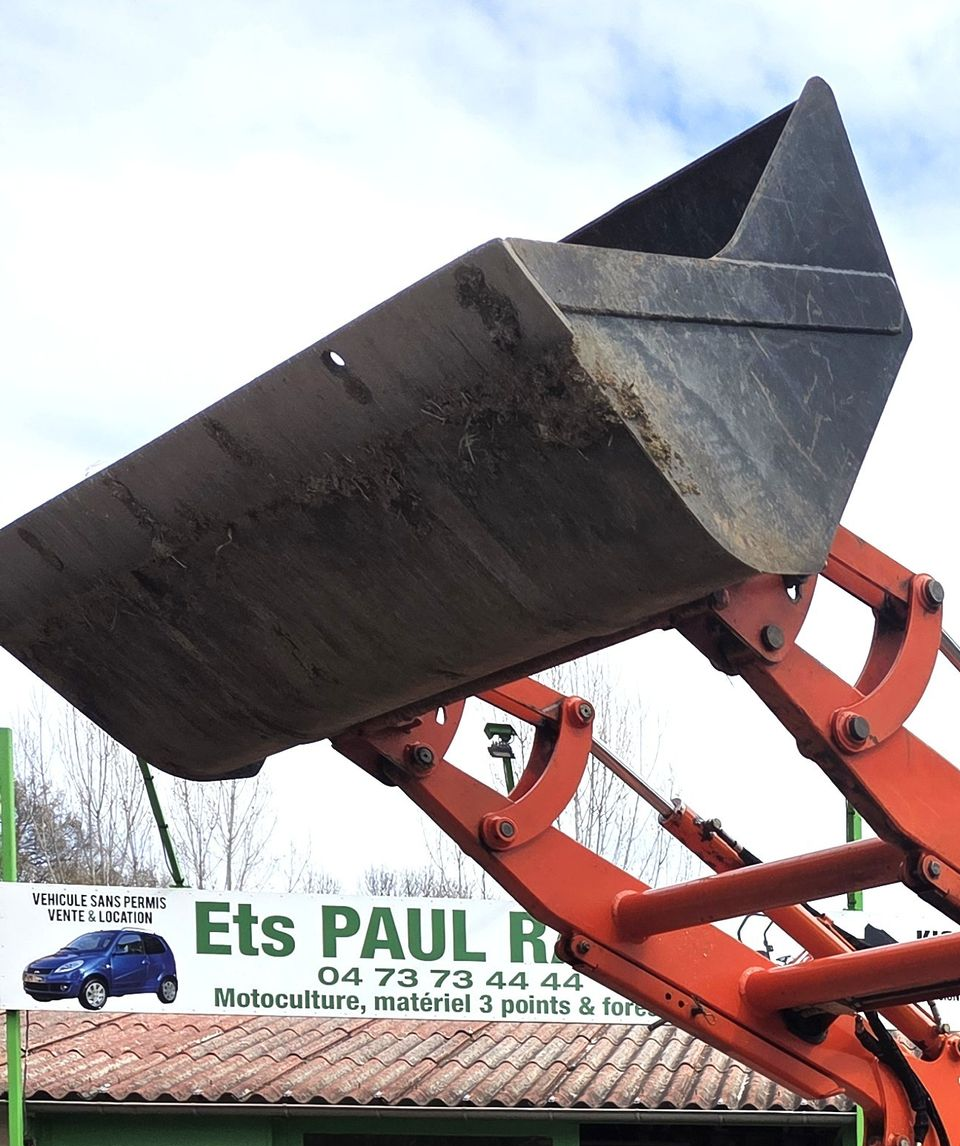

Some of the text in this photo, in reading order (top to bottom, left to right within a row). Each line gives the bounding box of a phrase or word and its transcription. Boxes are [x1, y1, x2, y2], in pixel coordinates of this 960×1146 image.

[32, 893, 167, 909] VEHICULE SANS PERMIS
[48, 909, 153, 924] VENTE & LOCATION
[195, 901, 296, 957] Ets
[322, 905, 487, 962] PAUL
[318, 966, 584, 991] 04 73 73 44 44
[214, 987, 366, 1014] Motoculture,
[374, 992, 471, 1013] matériel
[479, 994, 493, 1014] 3
[501, 995, 571, 1018] points
[579, 996, 595, 1016] &
